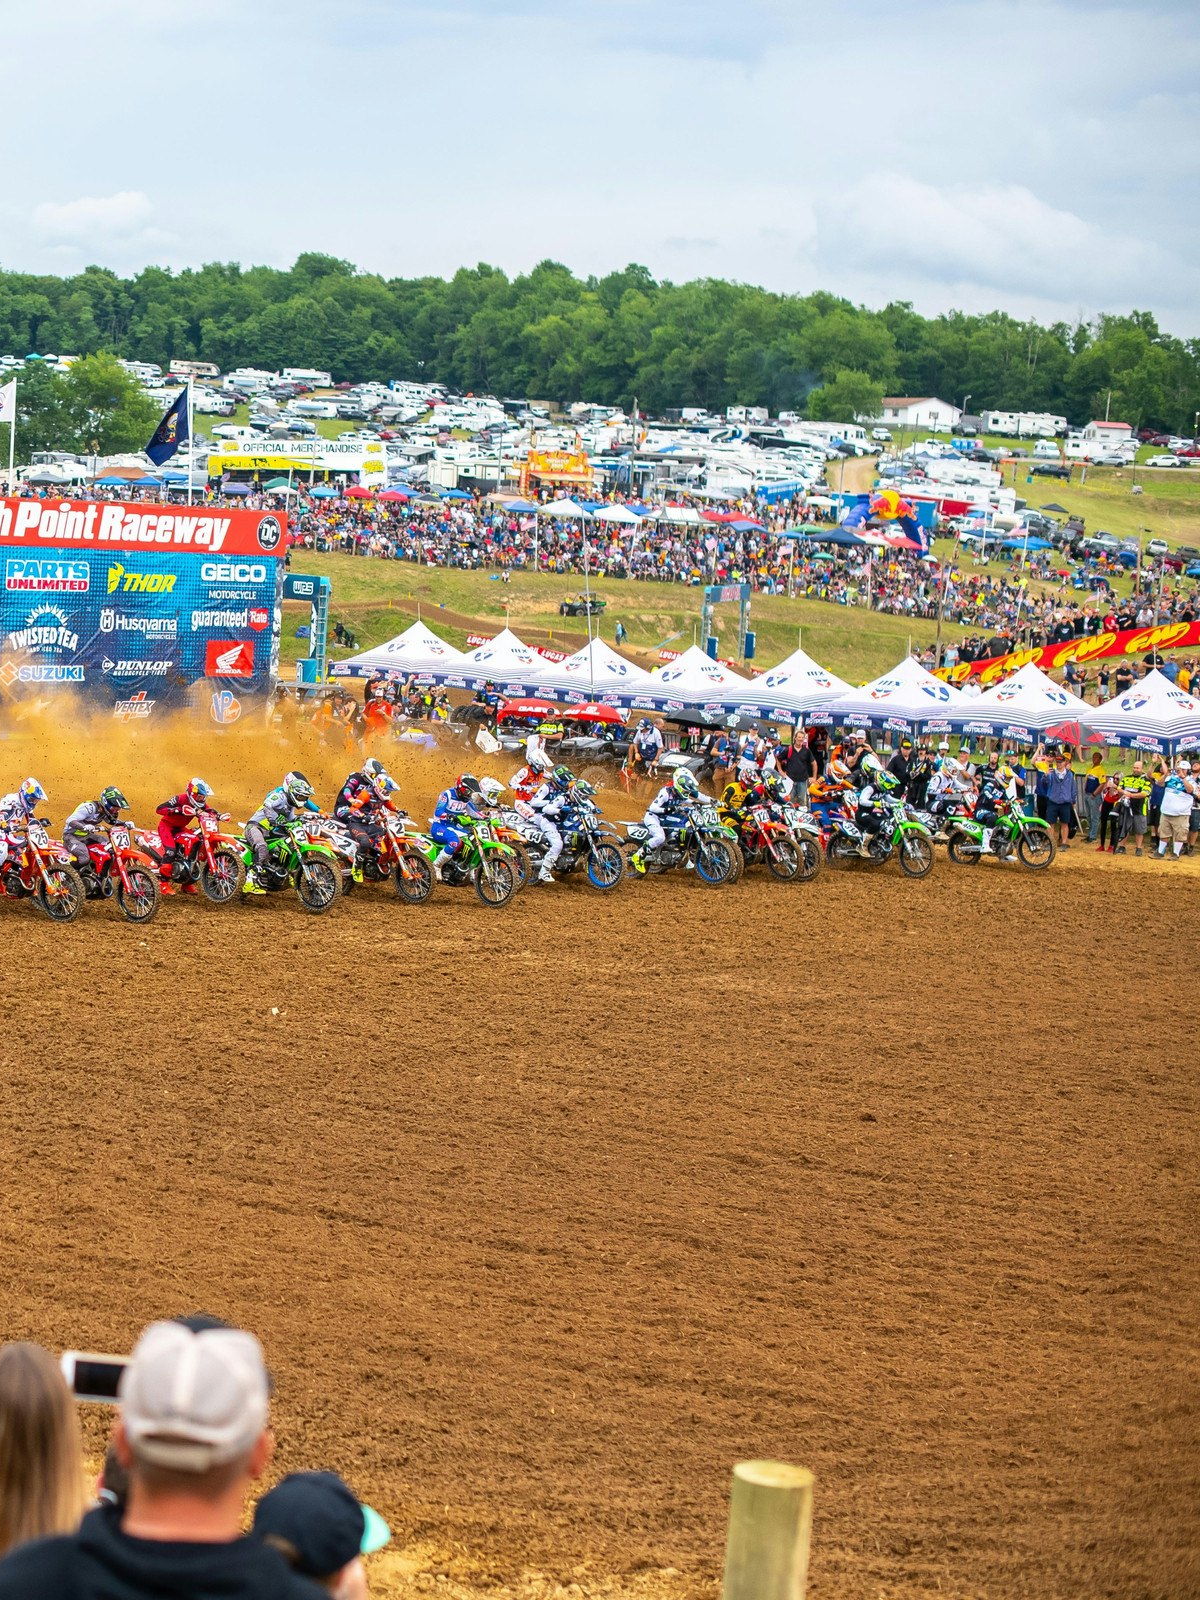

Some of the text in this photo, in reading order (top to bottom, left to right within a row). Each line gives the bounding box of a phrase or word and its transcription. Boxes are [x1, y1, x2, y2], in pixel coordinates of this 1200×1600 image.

[243, 444, 287, 452] OFFICIAL
[291, 443, 363, 454] MERCHANDISE
[14, 502, 98, 540] Point
[99, 506, 231, 551] Raceway
[7, 561, 89, 579] PARTS
[201, 563, 266, 583] GEICO
[7, 578, 88, 591] UNLIMITED
[123, 573, 176, 592] THOR
[209, 590, 256, 600] MOTORCYCLE
[116, 614, 177, 632] Husqvarna
[191, 608, 268, 631] guaranteed Rate
[8, 626, 79, 652] TWISTED TEA
[115, 660, 173, 671] DUNLOP
[19, 665, 85, 681] SUZUKI
[114, 701, 156, 714] VERTEX
[212, 690, 233, 722] VP
[295, 829, 307, 841] 3
[394, 822, 404, 835] 2
[480, 827, 490, 840] 9
[630, 828, 647, 838] 29
[34, 832, 49, 846] 25
[116, 834, 130, 848] 23
[529, 832, 541, 843] 14
[339, 839, 352, 852] 2
